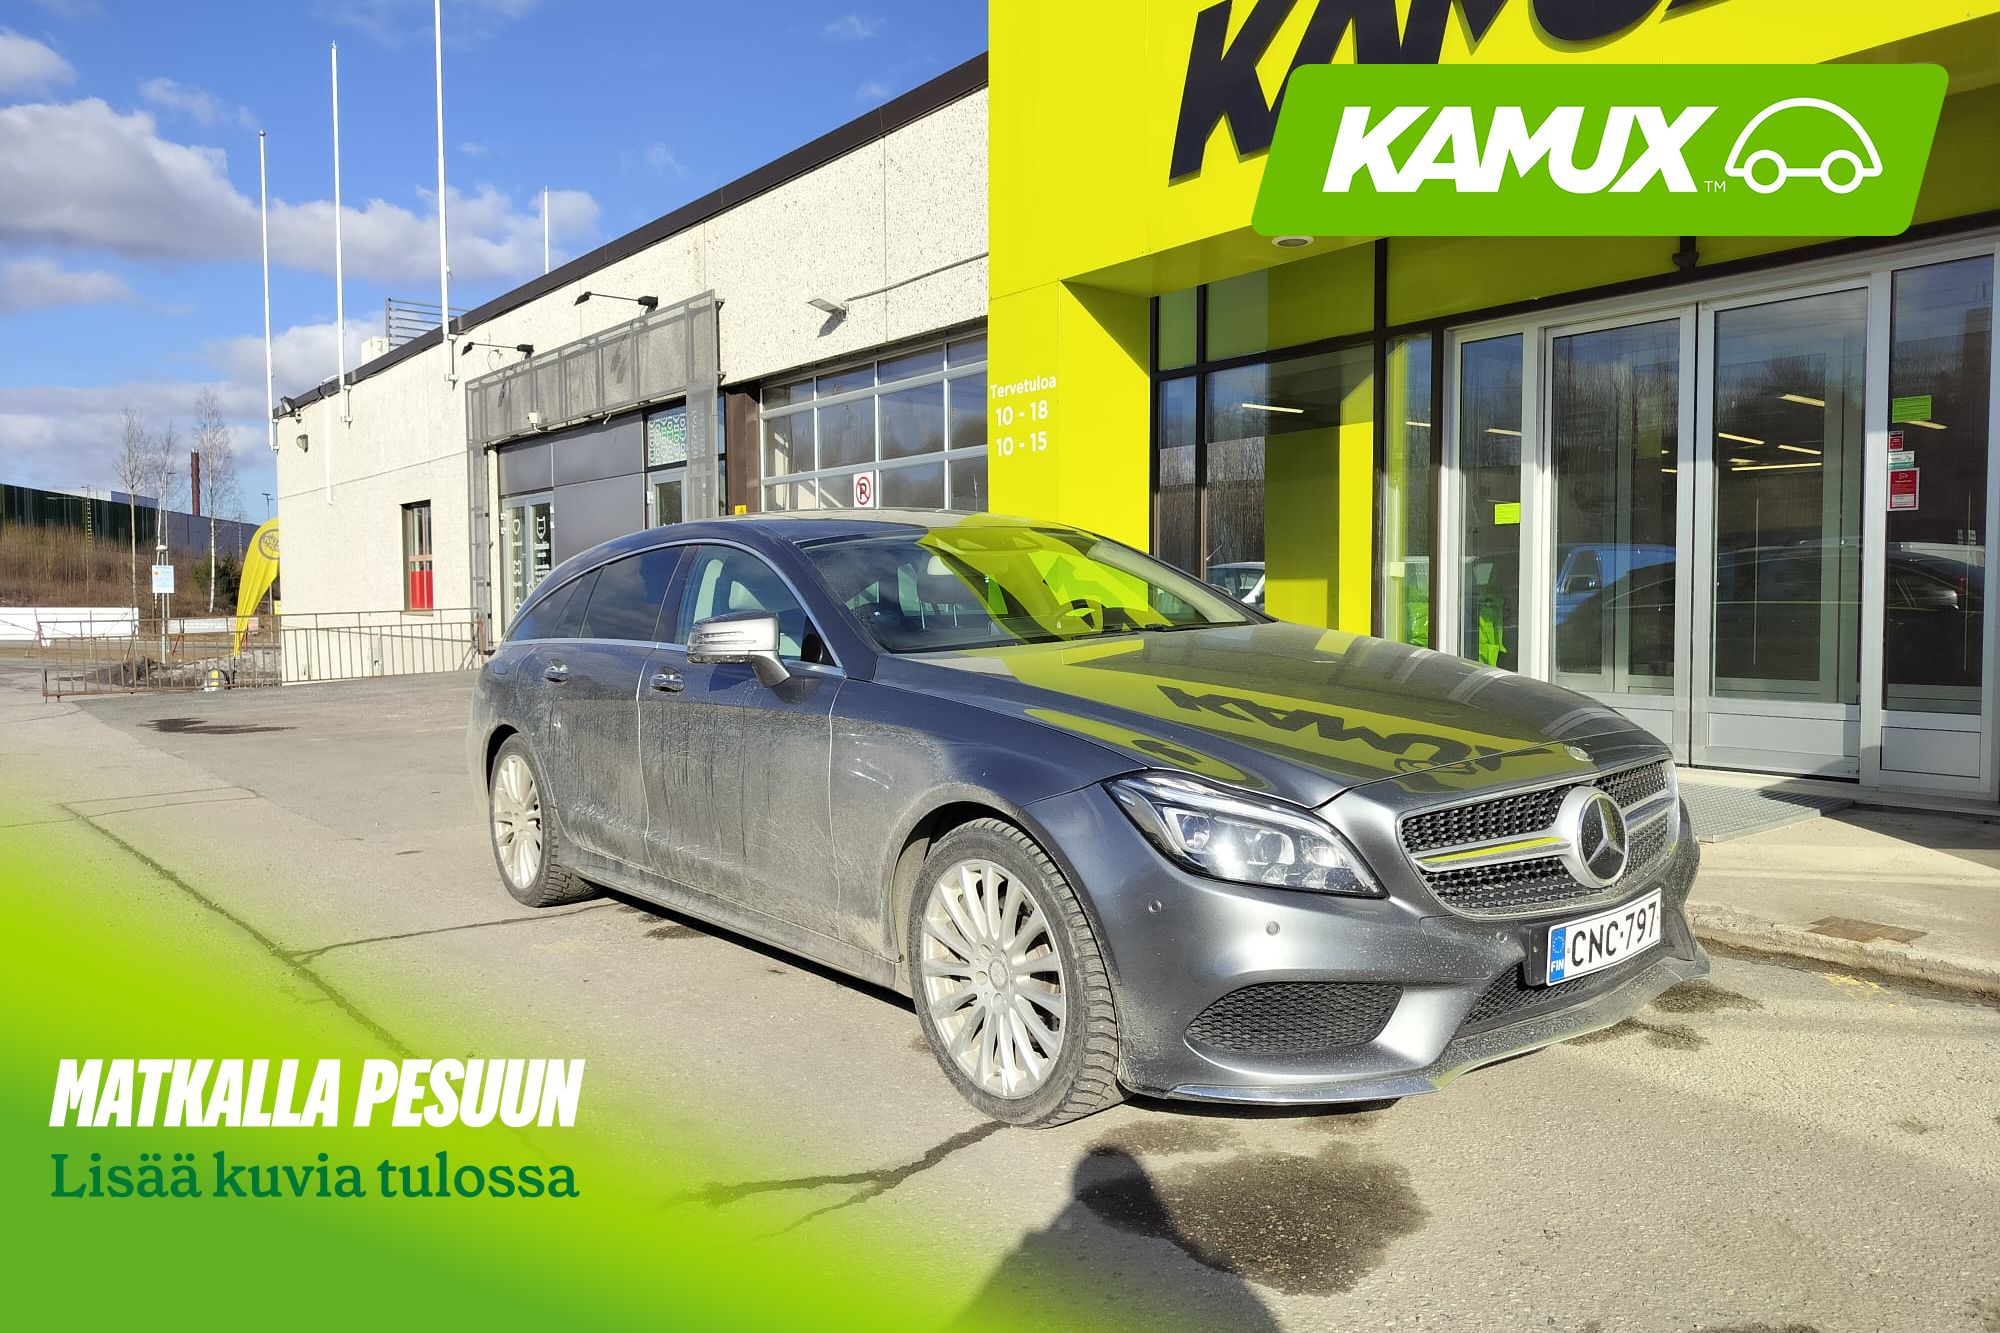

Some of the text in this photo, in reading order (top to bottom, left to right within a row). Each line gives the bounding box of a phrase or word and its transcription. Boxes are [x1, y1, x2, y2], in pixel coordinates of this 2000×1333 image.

[990, 375, 1057, 399] Tervetuloa
[995, 406, 1014, 427] 10
[1030, 399, 1049, 421] 18
[996, 436, 1014, 457] 10
[1030, 431, 1048, 452] 15
[1571, 901, 1657, 967] CNC-797
[1550, 957, 1565, 973] FIN
